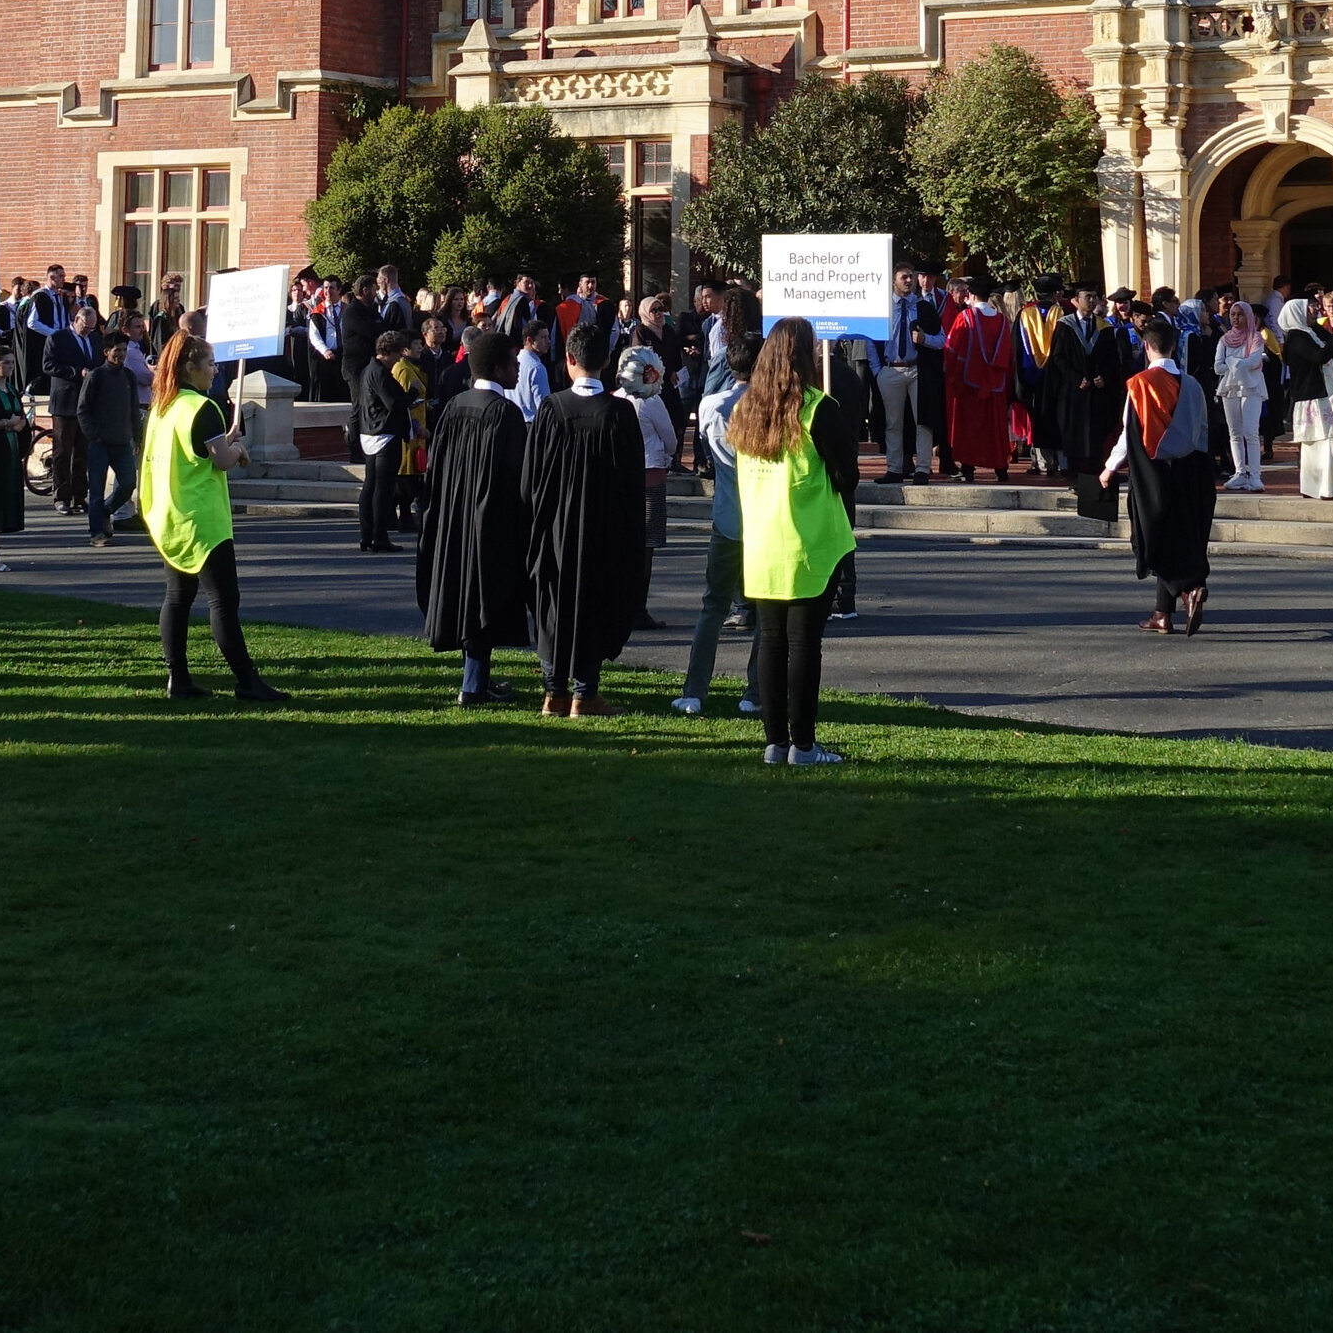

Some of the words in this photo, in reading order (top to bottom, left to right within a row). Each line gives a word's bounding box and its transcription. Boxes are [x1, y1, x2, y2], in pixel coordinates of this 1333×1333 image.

[789, 252, 844, 265] Bachelor
[847, 251, 860, 265] of
[768, 270, 797, 282] Land
[801, 270, 824, 282] and
[828, 270, 882, 285] Property
[783, 287, 866, 302] Management
